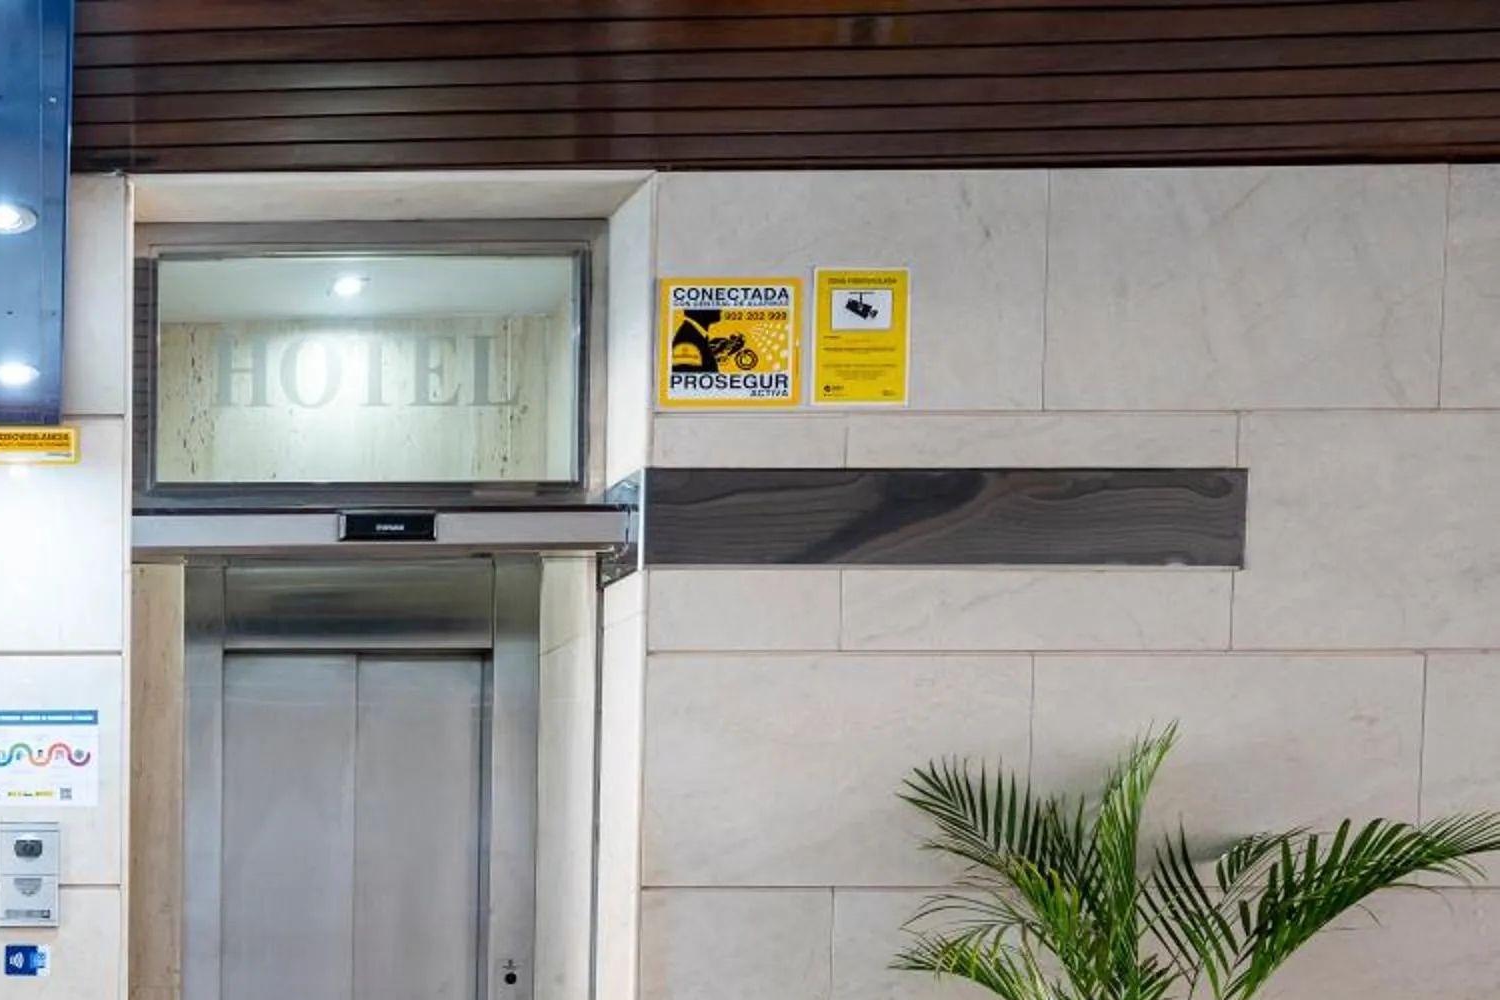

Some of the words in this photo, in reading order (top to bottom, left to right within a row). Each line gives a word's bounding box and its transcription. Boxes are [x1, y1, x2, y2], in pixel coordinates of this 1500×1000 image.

[673, 287, 789, 301] CONECTADA
[213, 333, 522, 409] HOTEL
[670, 374, 789, 390] PROSEGUR
